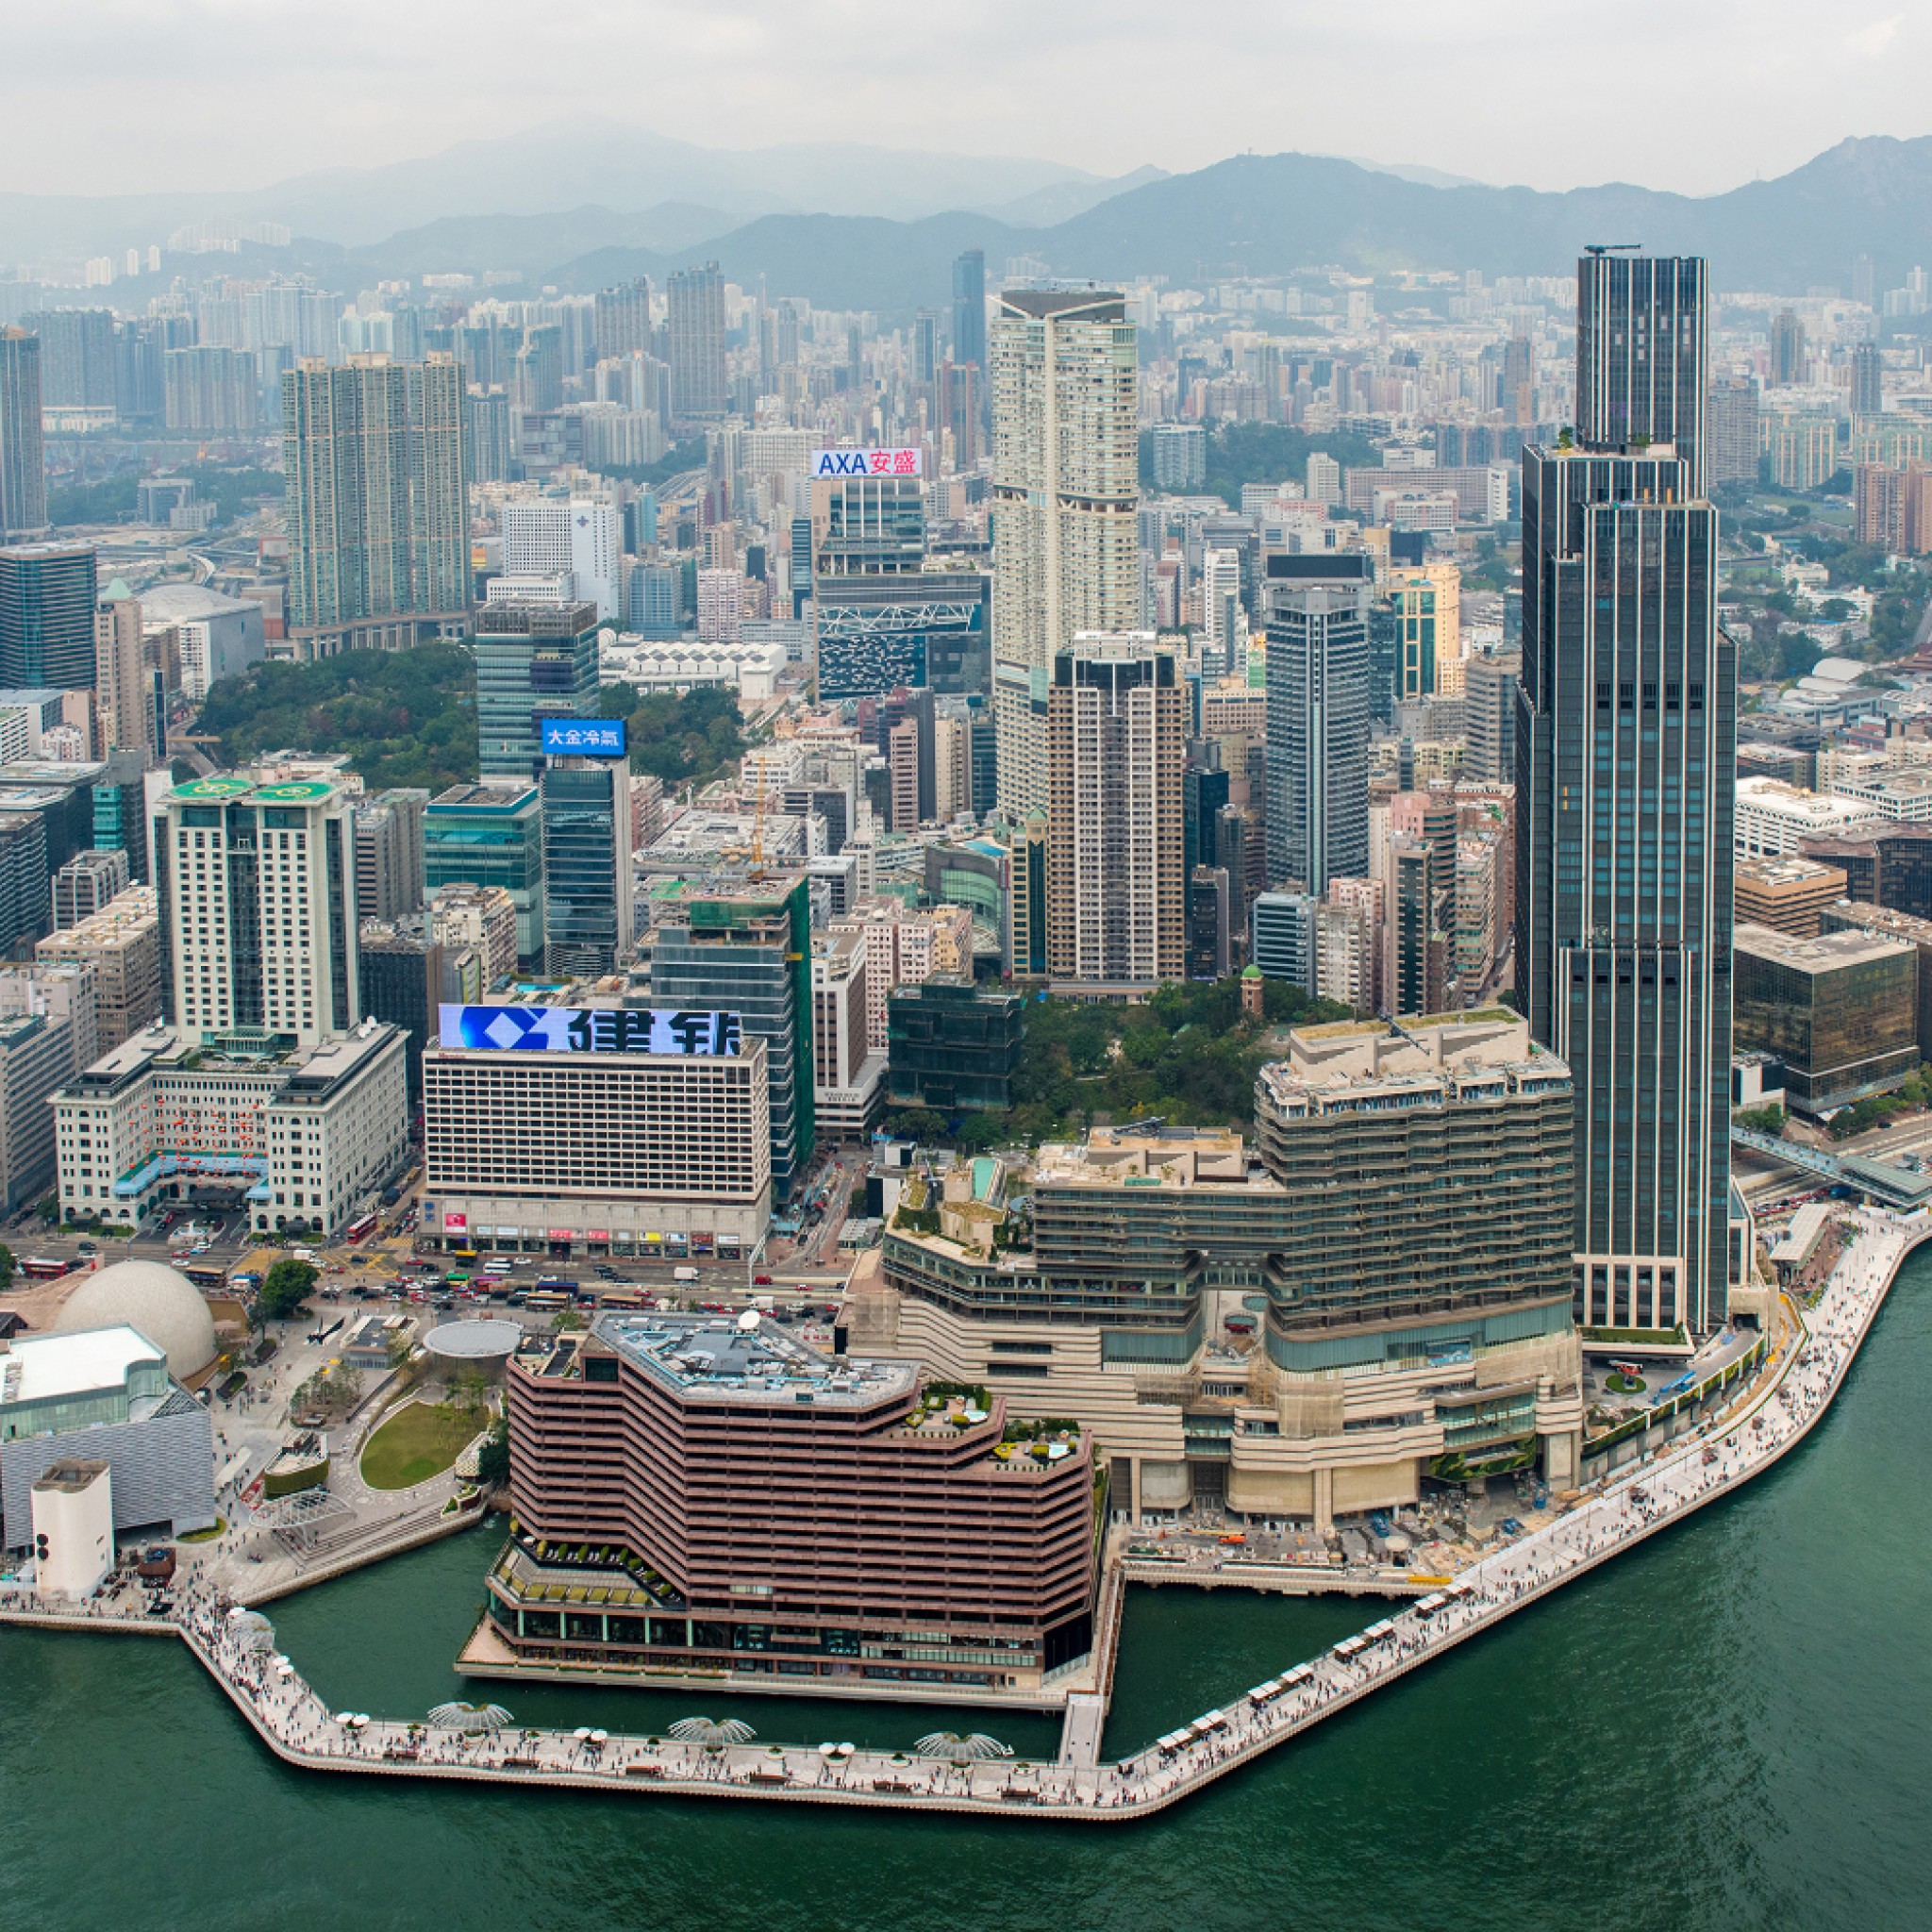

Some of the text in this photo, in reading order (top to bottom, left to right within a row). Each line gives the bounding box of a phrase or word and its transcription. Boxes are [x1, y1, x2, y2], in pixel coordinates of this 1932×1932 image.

[819, 450, 917, 475] AXA 安盛
[547, 728, 619, 746] 大金冷氣
